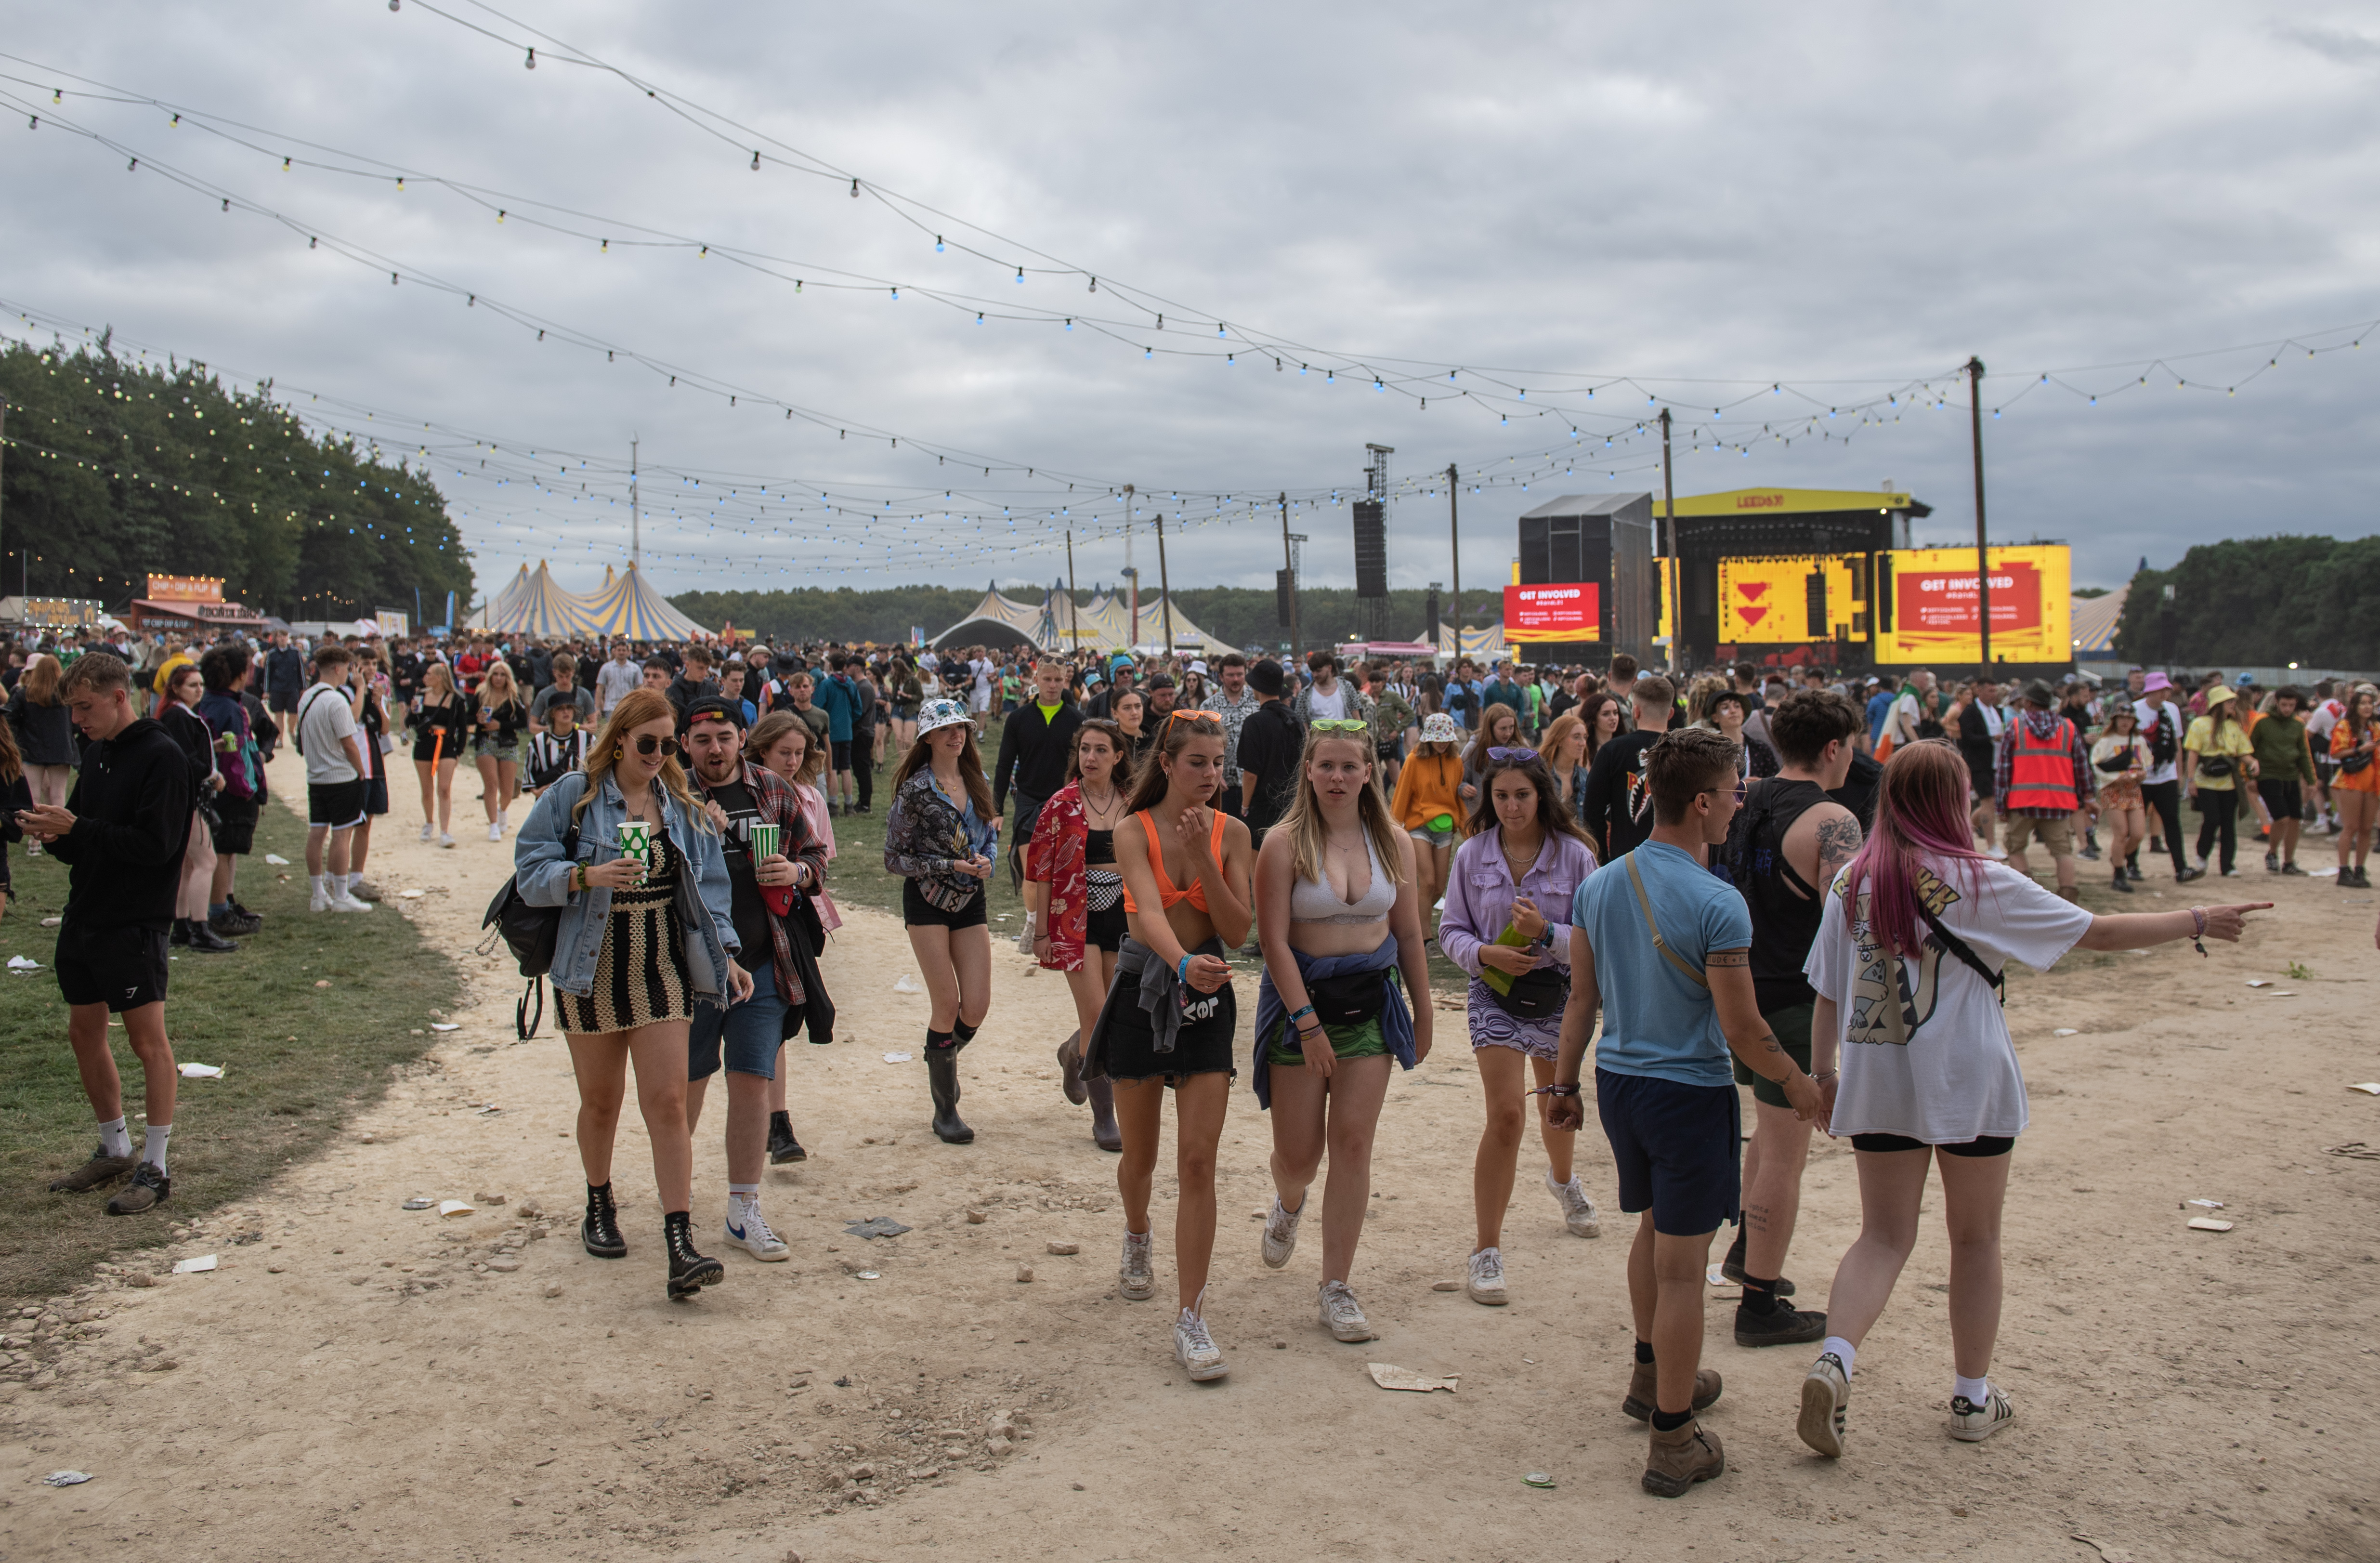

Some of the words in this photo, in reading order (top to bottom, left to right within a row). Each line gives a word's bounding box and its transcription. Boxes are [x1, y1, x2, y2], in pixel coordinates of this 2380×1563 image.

[152, 580, 169, 591] CHIP
[175, 582, 187, 591] DIP
[1921, 579, 1946, 591] GET
[1948, 577, 2014, 590] INVOVED
[1519, 591, 1536, 600] GET
[1538, 589, 1581, 600] INVOLVED
